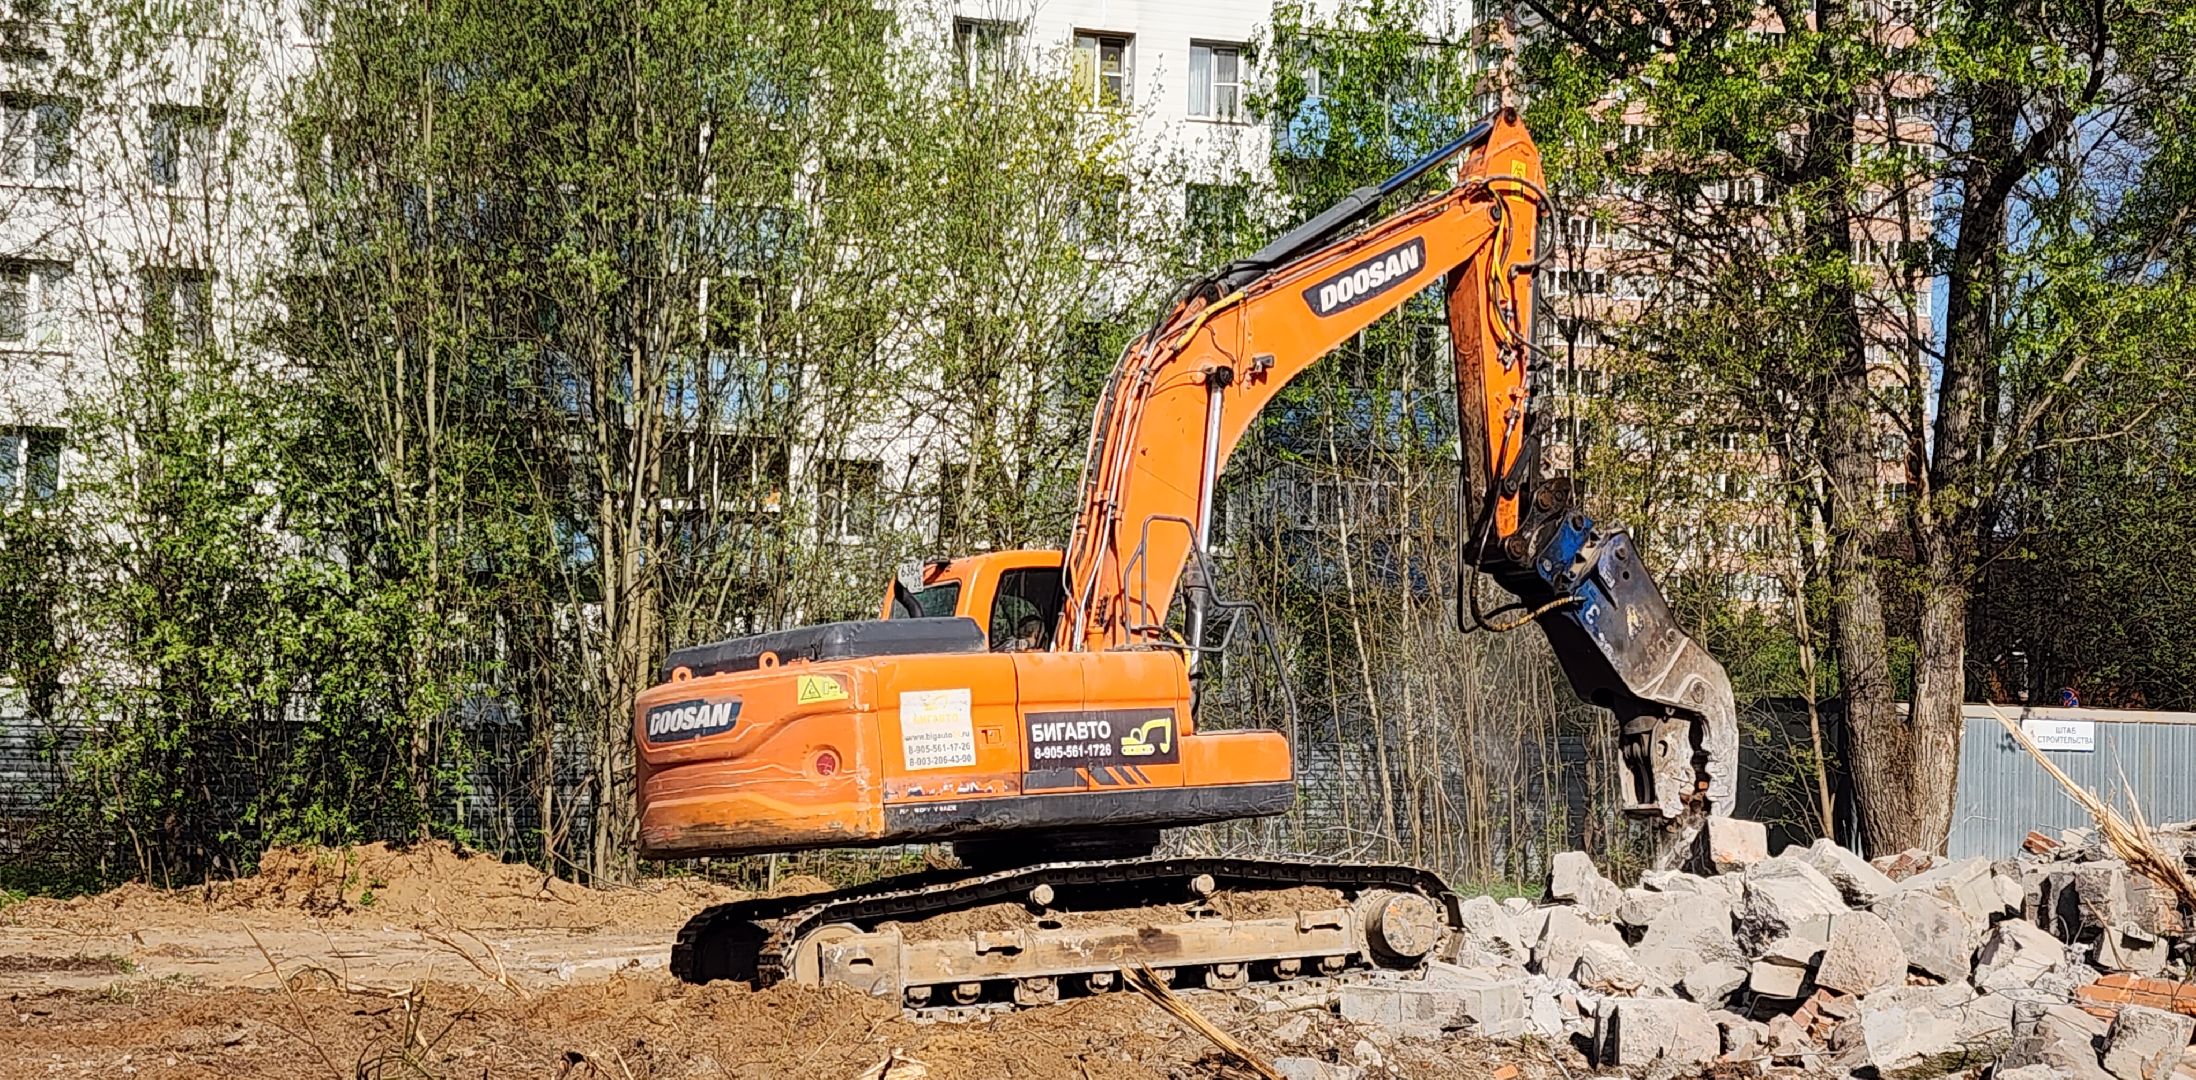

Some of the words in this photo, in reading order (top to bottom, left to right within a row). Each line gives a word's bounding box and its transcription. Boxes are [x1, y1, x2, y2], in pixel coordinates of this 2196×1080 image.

[1320, 245, 1419, 313] DOOSAN
[650, 703, 732, 735] DOOSAN
[1032, 721, 1112, 742] БИГАВТО
[2055, 727, 2076, 735] ШТАБ
[2037, 736, 2093, 744] СТРОИТЕЛЬСТВА
[908, 743, 971, 754] 8-905-561-17-26
[1034, 744, 1112, 759] 8-905-561-1726
